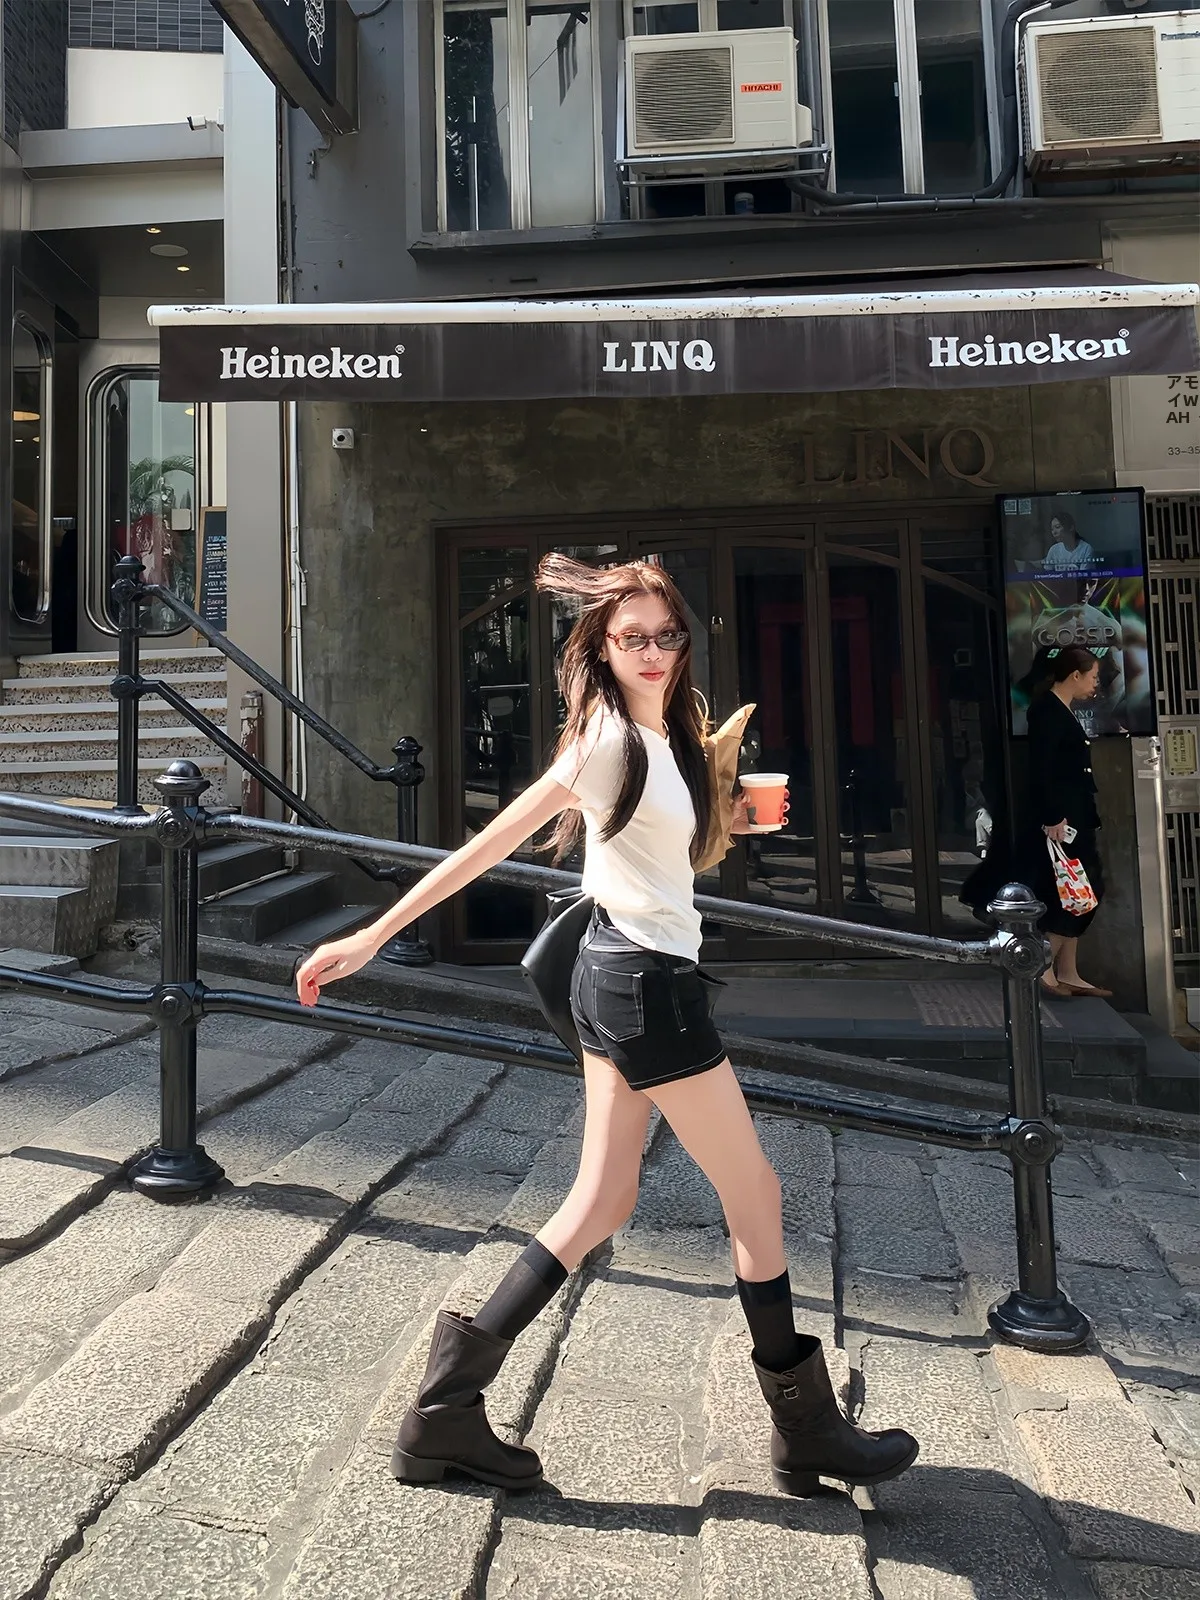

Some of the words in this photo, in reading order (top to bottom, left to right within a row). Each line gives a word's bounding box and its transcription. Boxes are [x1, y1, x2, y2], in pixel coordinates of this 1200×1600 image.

[744, 84, 779, 92] HITACHI
[603, 339, 716, 373] LINQ
[1166, 411, 1190, 424] AH
[797, 427, 1000, 488] LINQ
[1038, 626, 1115, 646] GOSSIP
